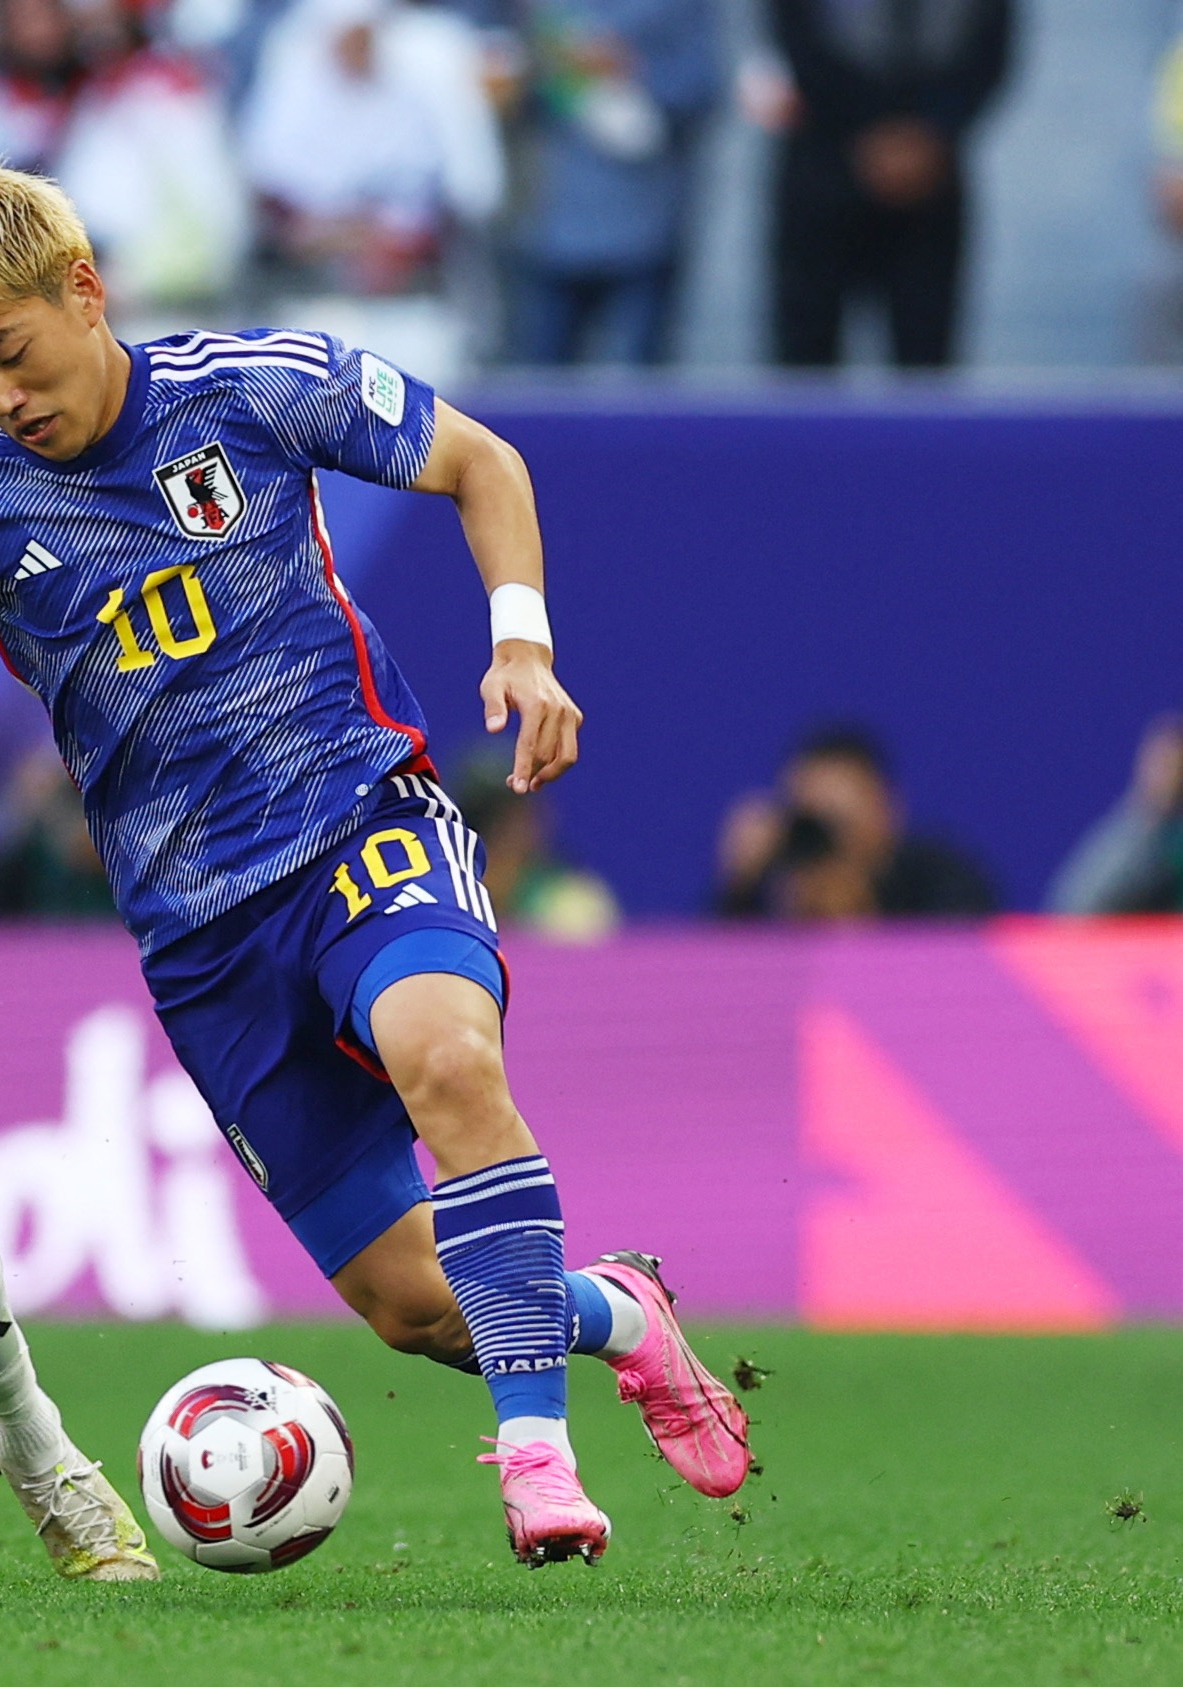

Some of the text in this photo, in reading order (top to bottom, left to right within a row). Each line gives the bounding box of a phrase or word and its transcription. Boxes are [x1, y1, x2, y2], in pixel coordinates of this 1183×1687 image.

[376, 367, 387, 408] LIVE
[172, 452, 206, 474] JAPAN
[96, 565, 217, 673] 10
[328, 828, 432, 924] 10
